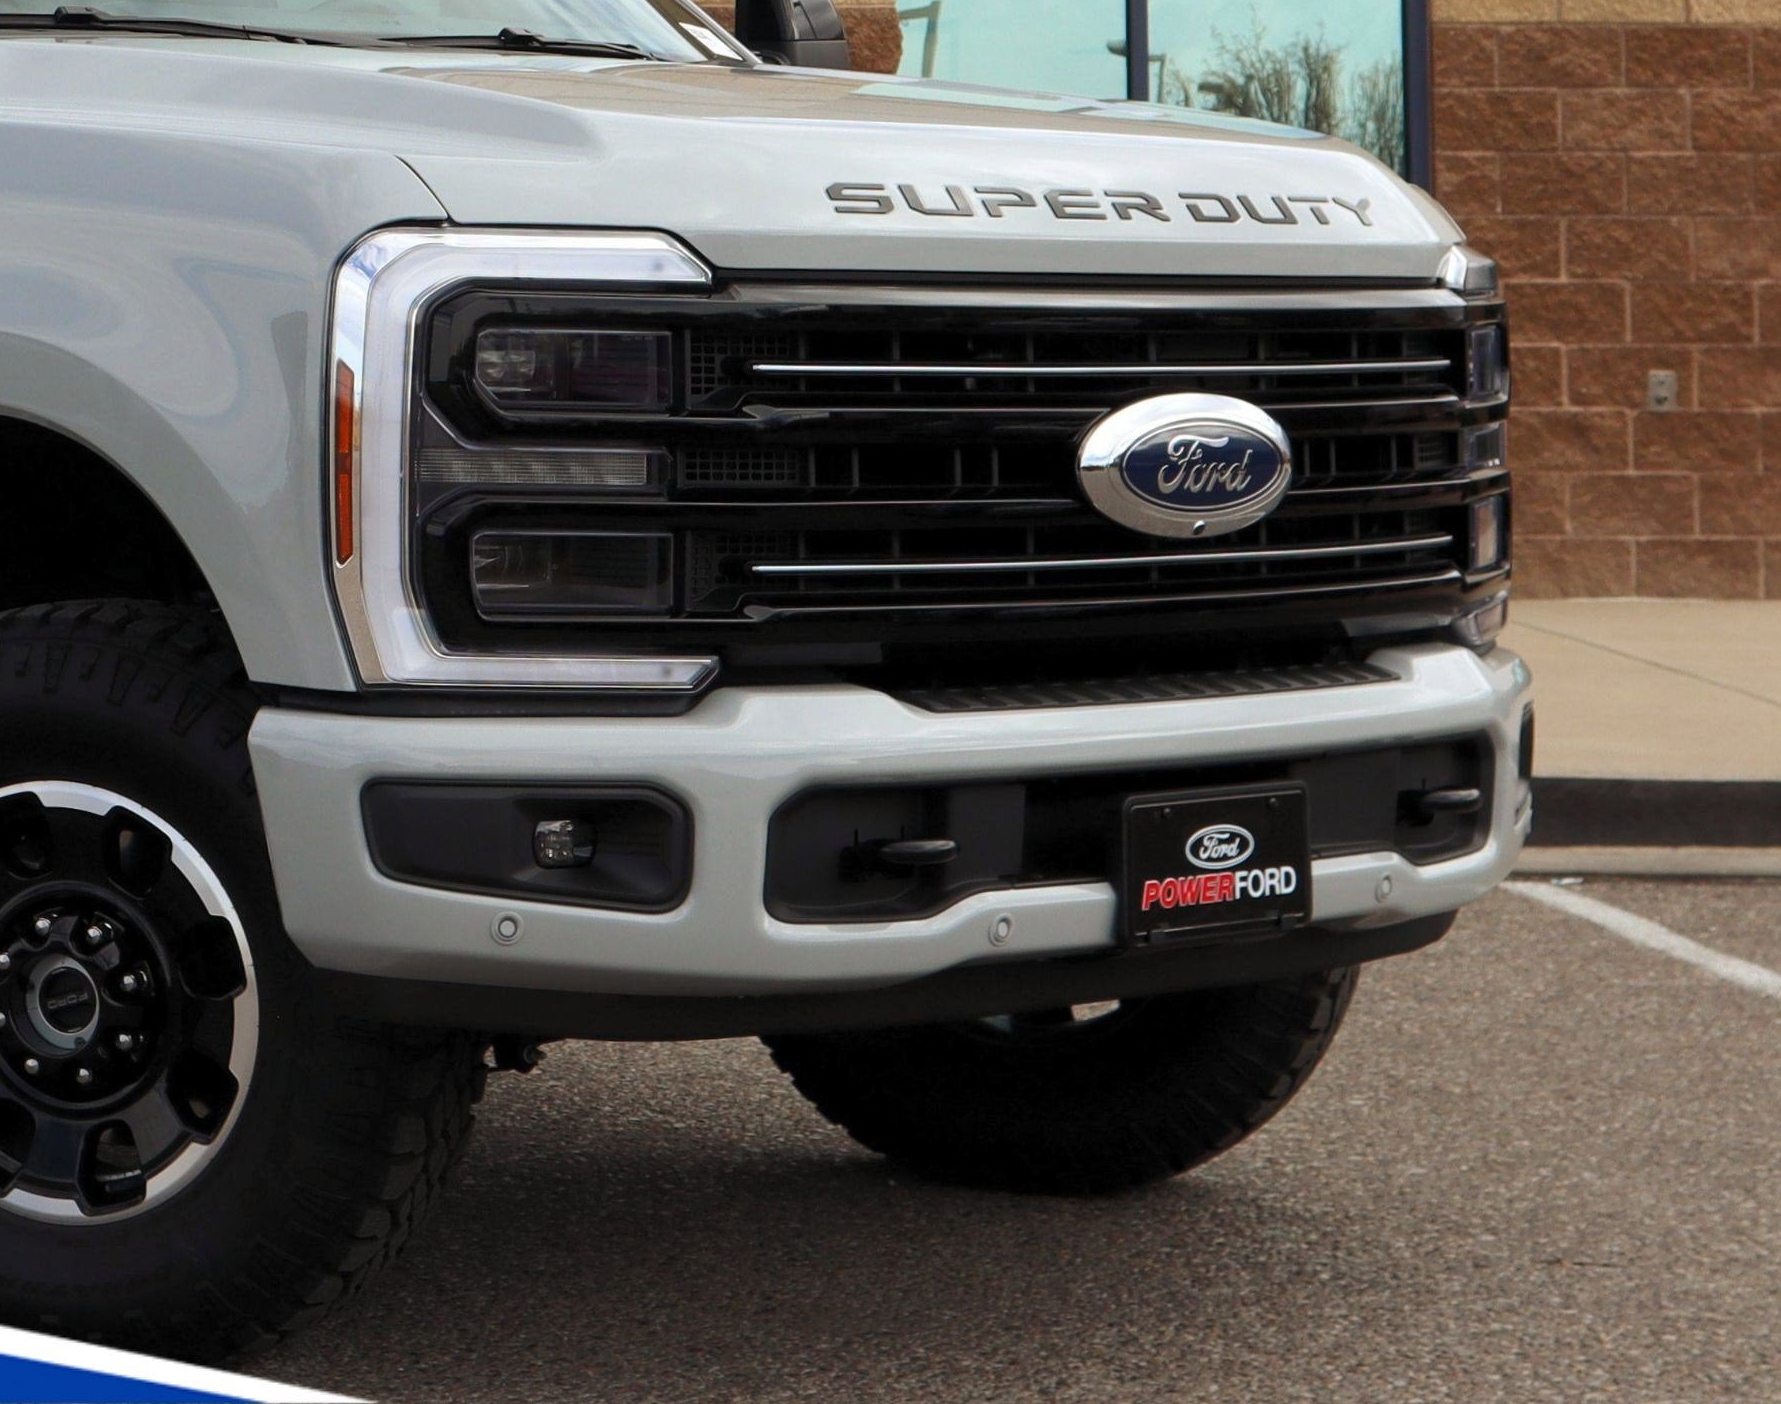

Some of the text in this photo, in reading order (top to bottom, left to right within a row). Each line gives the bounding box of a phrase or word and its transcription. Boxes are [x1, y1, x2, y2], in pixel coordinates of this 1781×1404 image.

[825, 182, 1373, 227] SUPER DUTY
[1157, 434, 1254, 494] Ford
[1199, 833, 1240, 860] Ford
